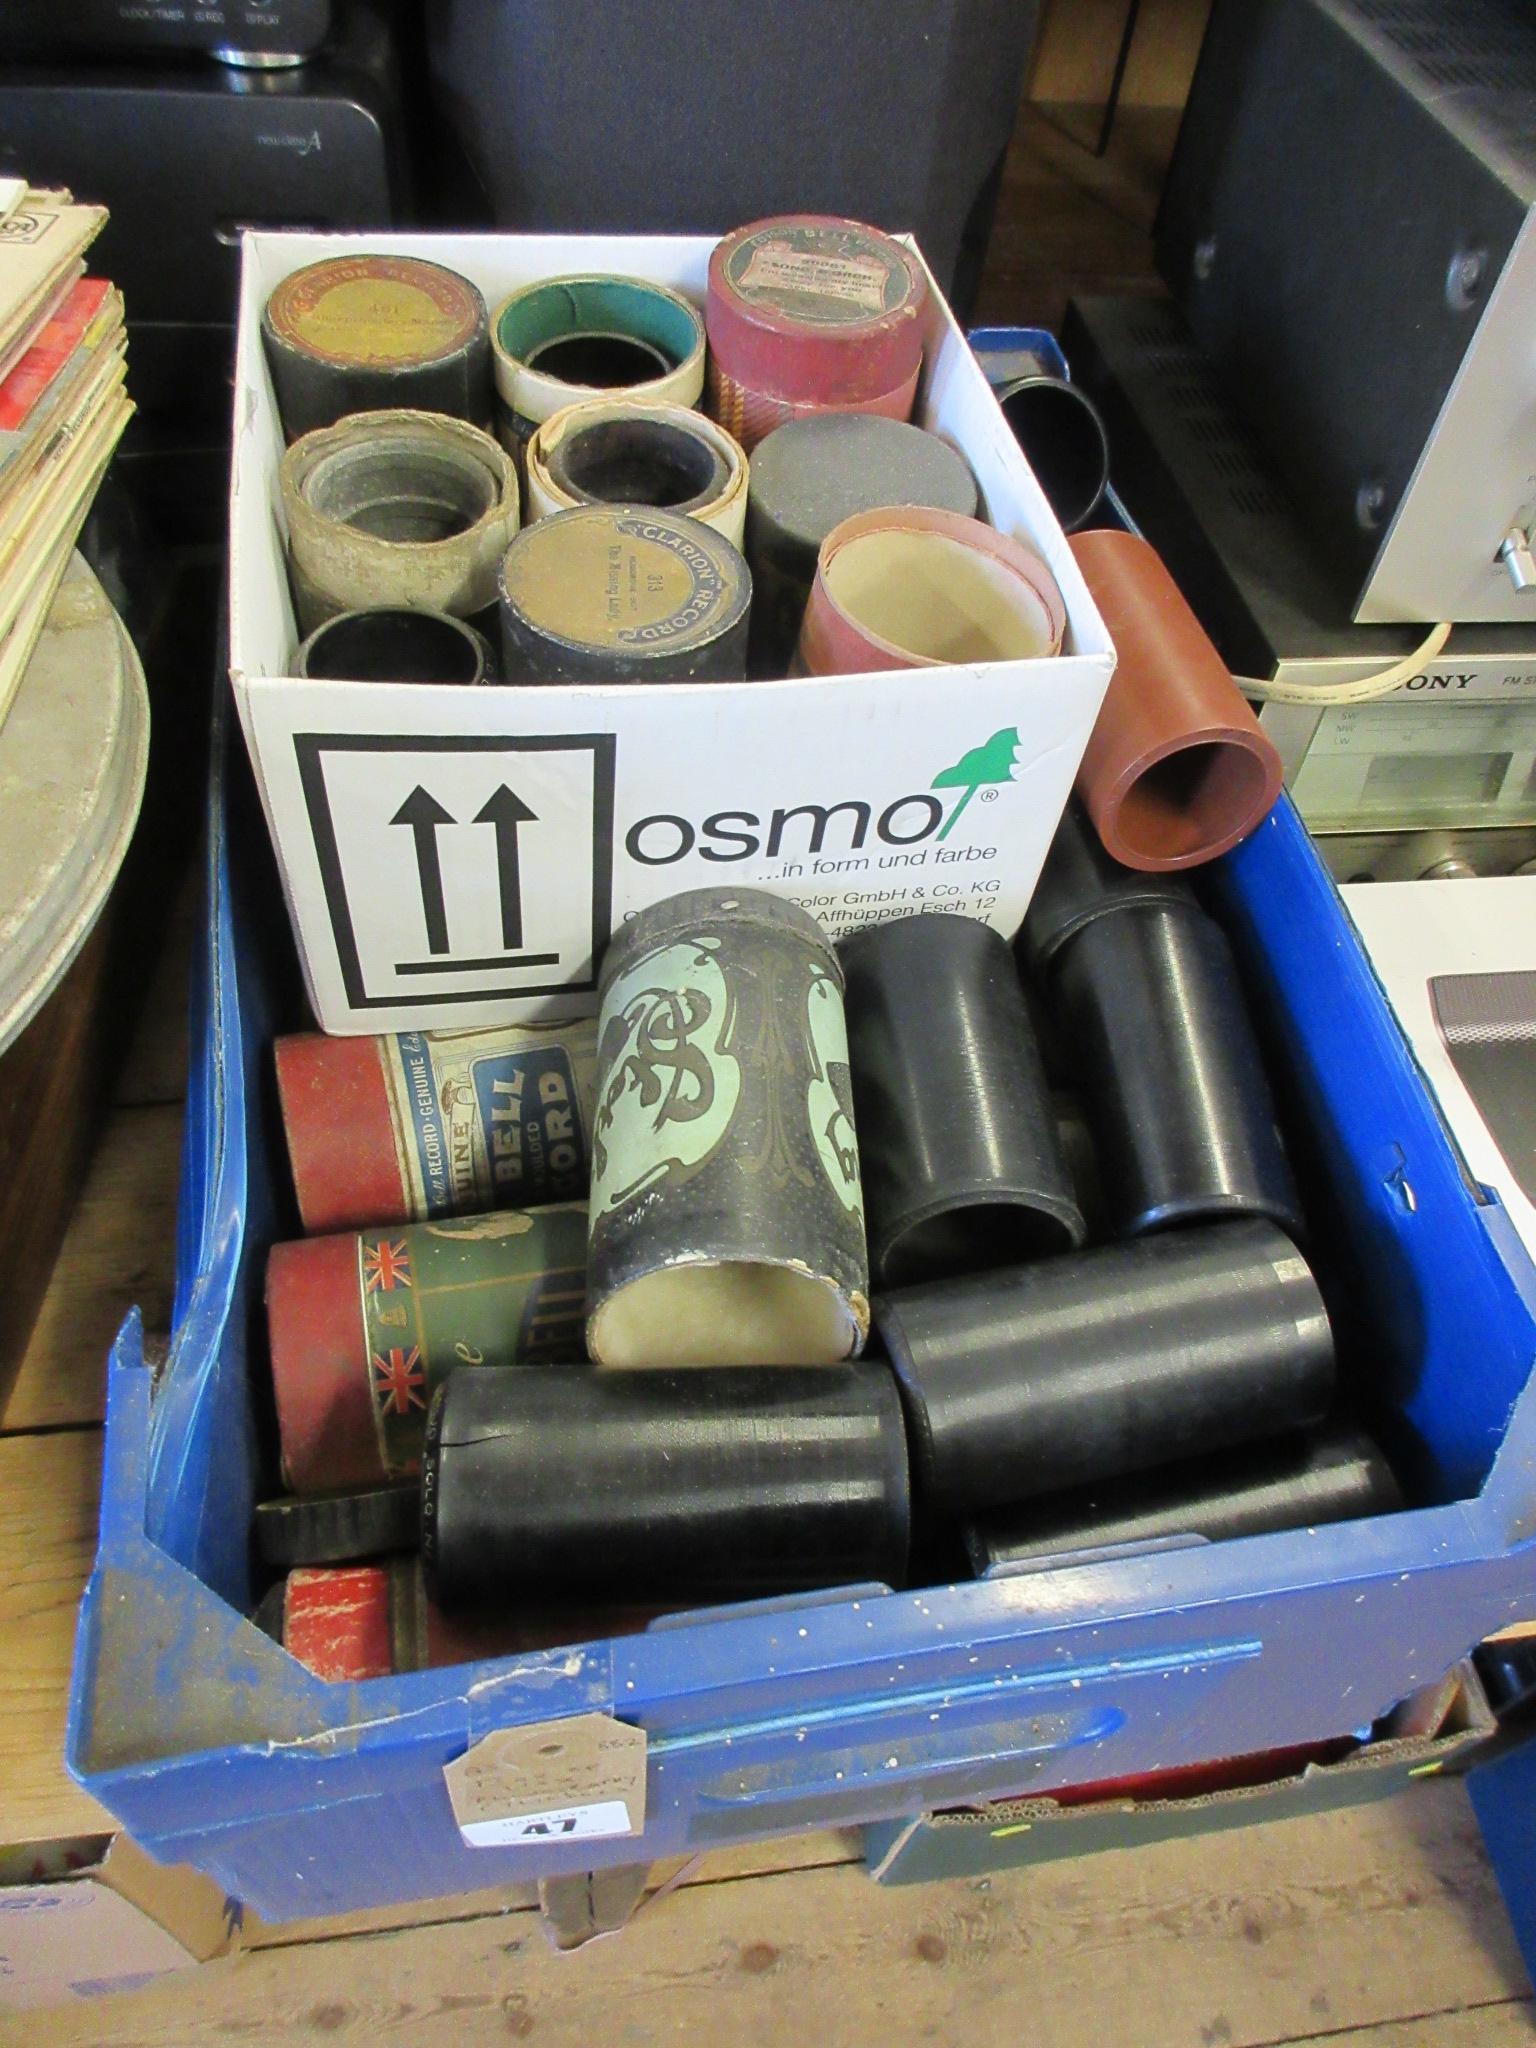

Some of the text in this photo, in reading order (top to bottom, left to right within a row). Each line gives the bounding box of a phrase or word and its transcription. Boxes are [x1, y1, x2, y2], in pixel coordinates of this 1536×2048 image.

[641, 588, 714, 640] RECORD
[1392, 674, 1477, 691] ONY
[624, 794, 944, 866] osmo
[812, 856, 869, 875] form
[878, 851, 926, 870] und
[935, 843, 998, 864] farbe
[816, 896, 998, 924] Affhüppen Esch 12
[843, 887, 907, 905] GmbH
[911, 887, 926, 899] &
[932, 883, 964, 897] Co.
[970, 879, 1001, 894] KG
[412, 1057, 433, 1116] GENUINE
[424, 1123, 444, 1176] RECORD
[493, 1069, 525, 1183] BELL
